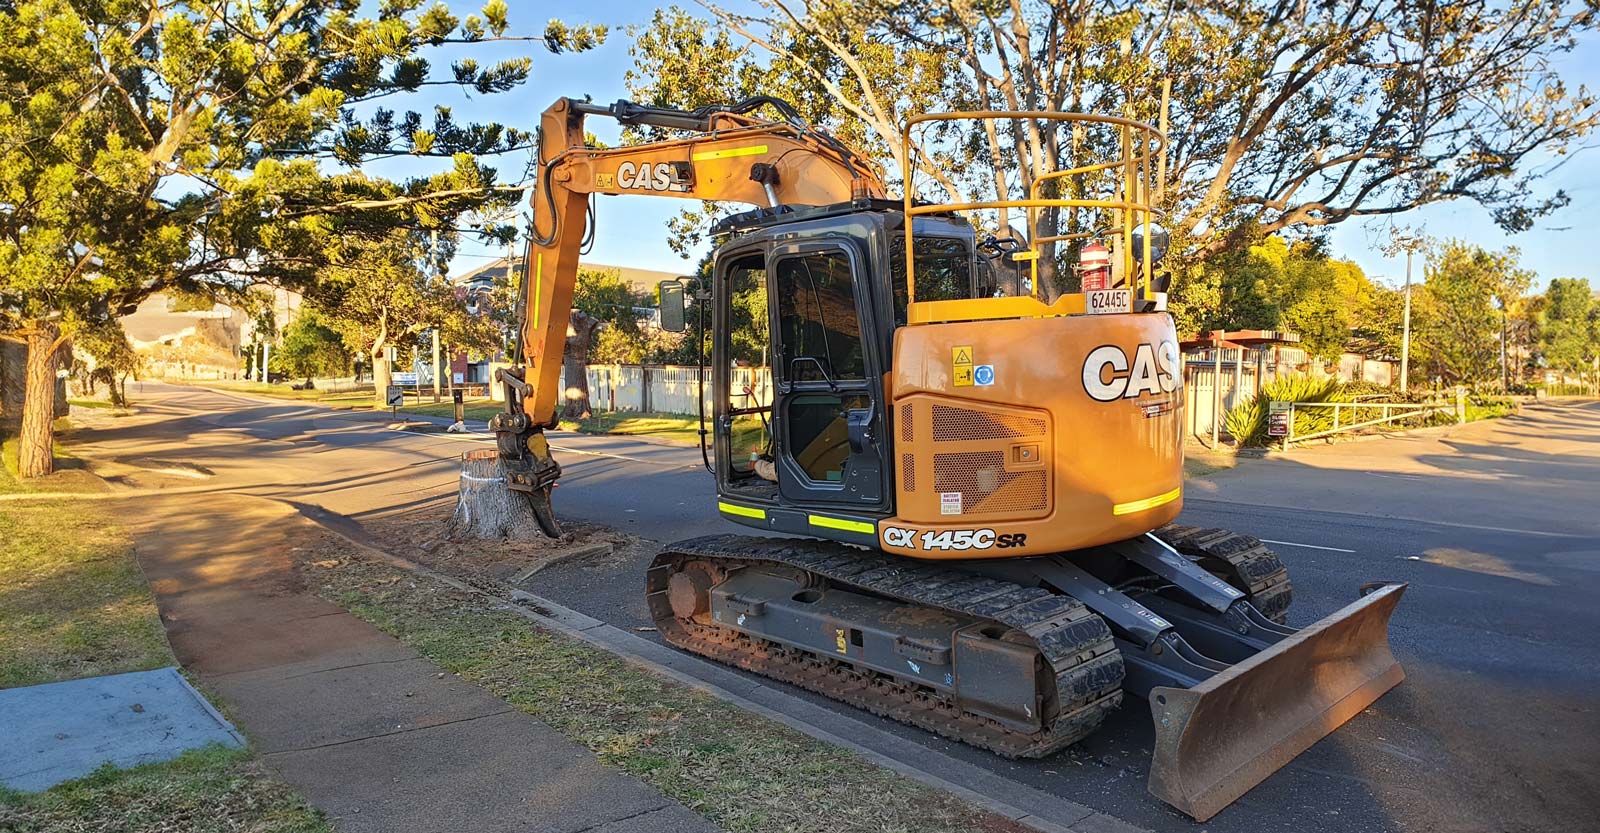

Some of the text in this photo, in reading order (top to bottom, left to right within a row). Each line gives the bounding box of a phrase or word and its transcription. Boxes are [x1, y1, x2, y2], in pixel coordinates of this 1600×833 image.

[617, 161, 689, 192] CAS
[1092, 292, 1127, 309] 62445C
[1081, 340, 1183, 402] CAS
[883, 527, 1027, 550] CX 145C SR
